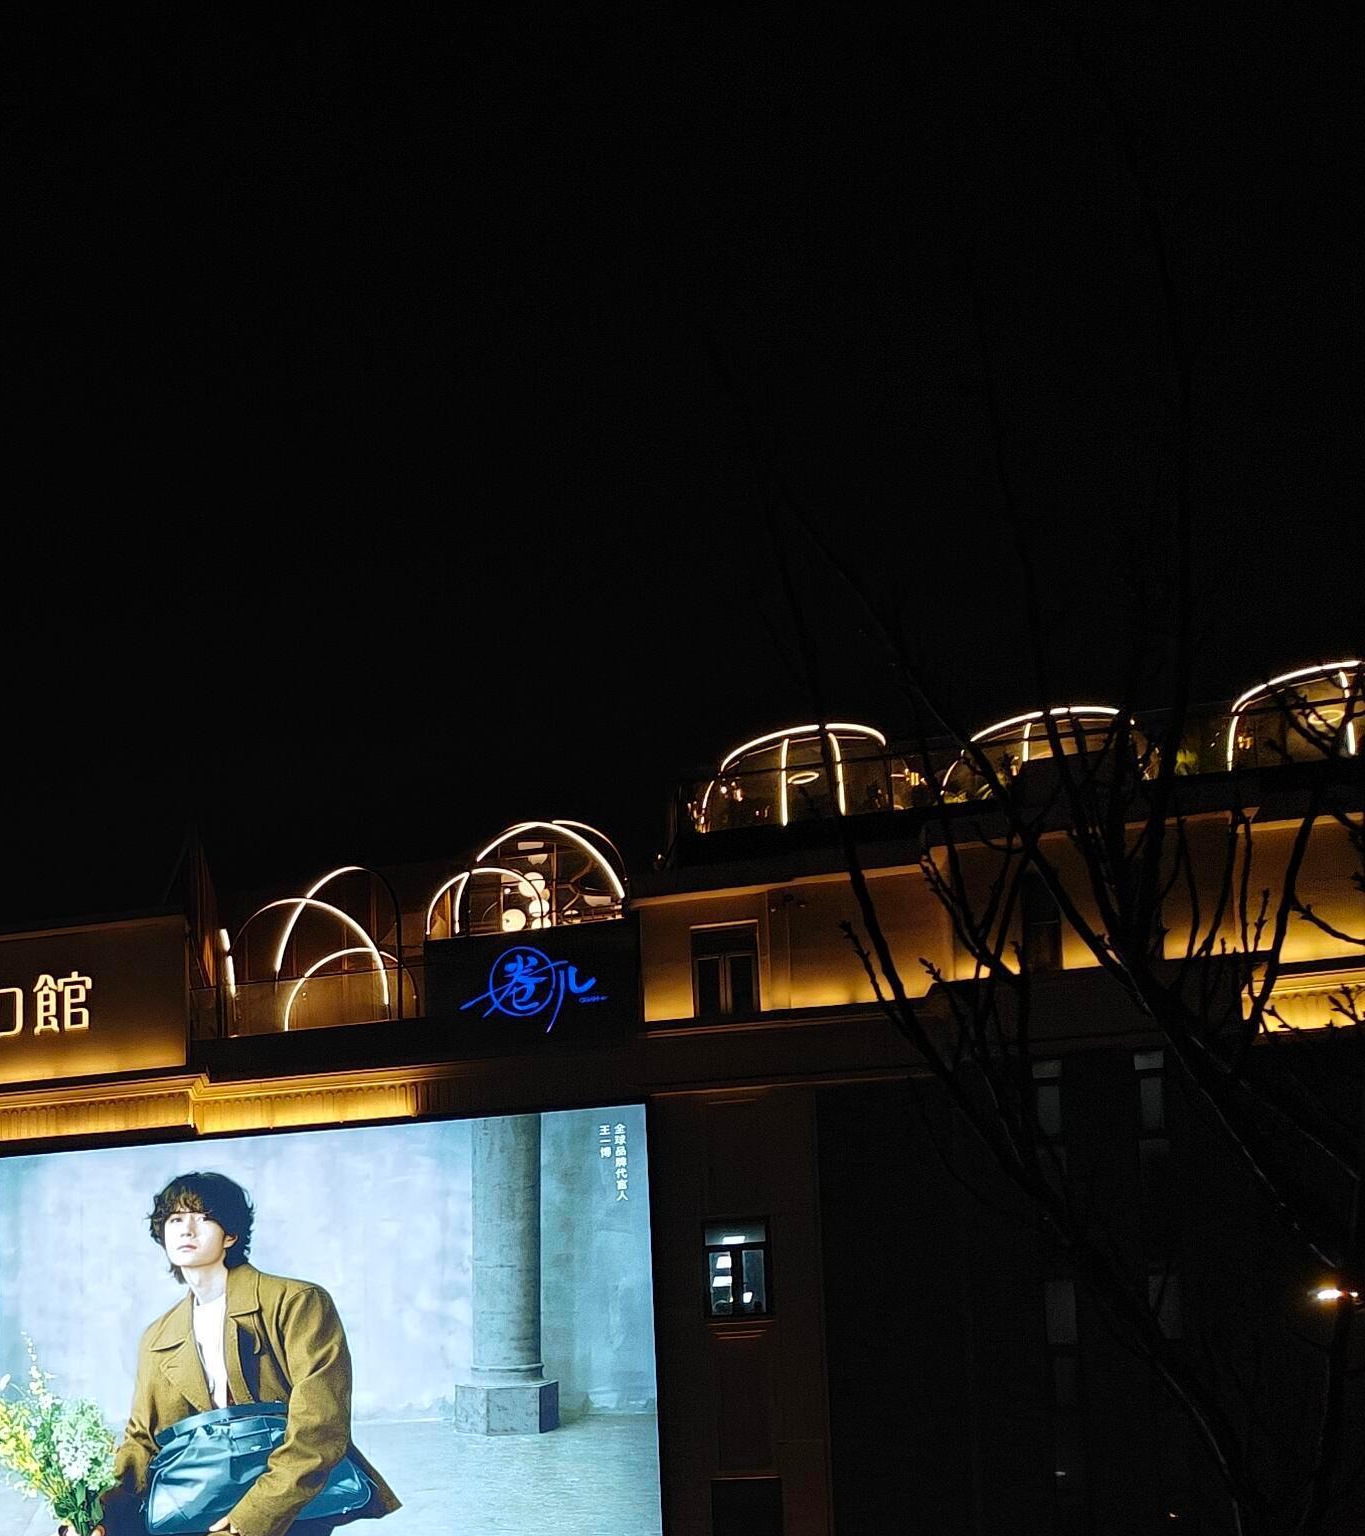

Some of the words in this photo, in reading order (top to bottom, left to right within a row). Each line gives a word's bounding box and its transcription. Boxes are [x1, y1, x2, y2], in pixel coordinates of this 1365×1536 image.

[598, 1124, 612, 1159] 王一博
[613, 1123, 629, 1201] 全球品牌代言人
